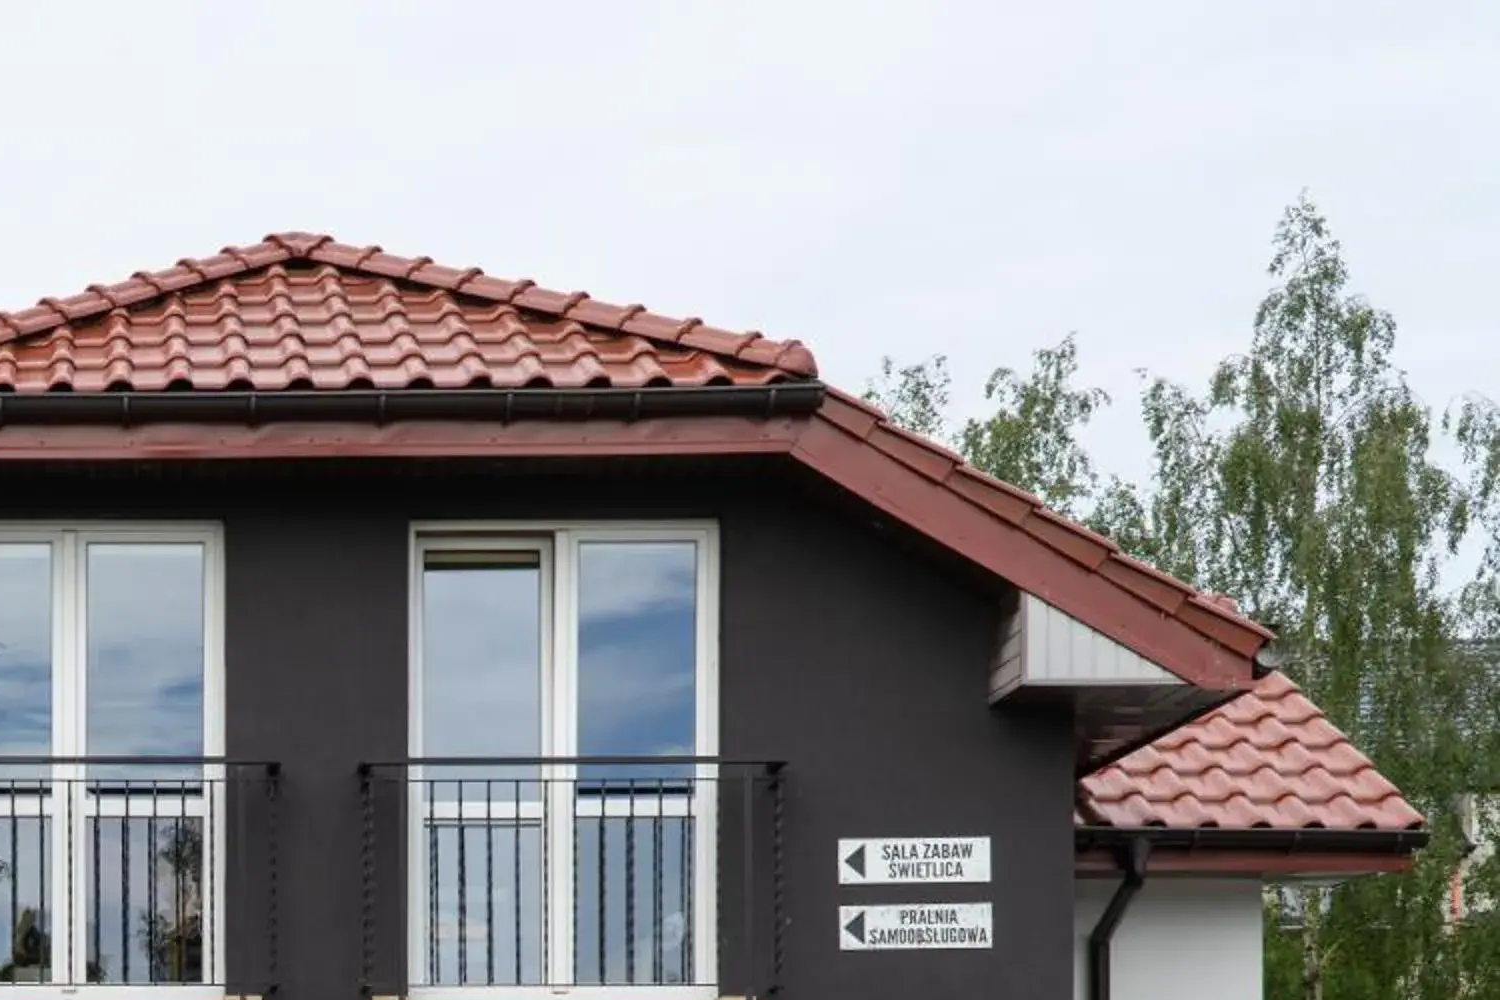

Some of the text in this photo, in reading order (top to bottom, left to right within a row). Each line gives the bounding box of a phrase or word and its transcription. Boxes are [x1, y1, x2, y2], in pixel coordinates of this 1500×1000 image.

[882, 843, 973, 861] SALA ZABAW
[900, 909, 959, 925] PRALNIA
